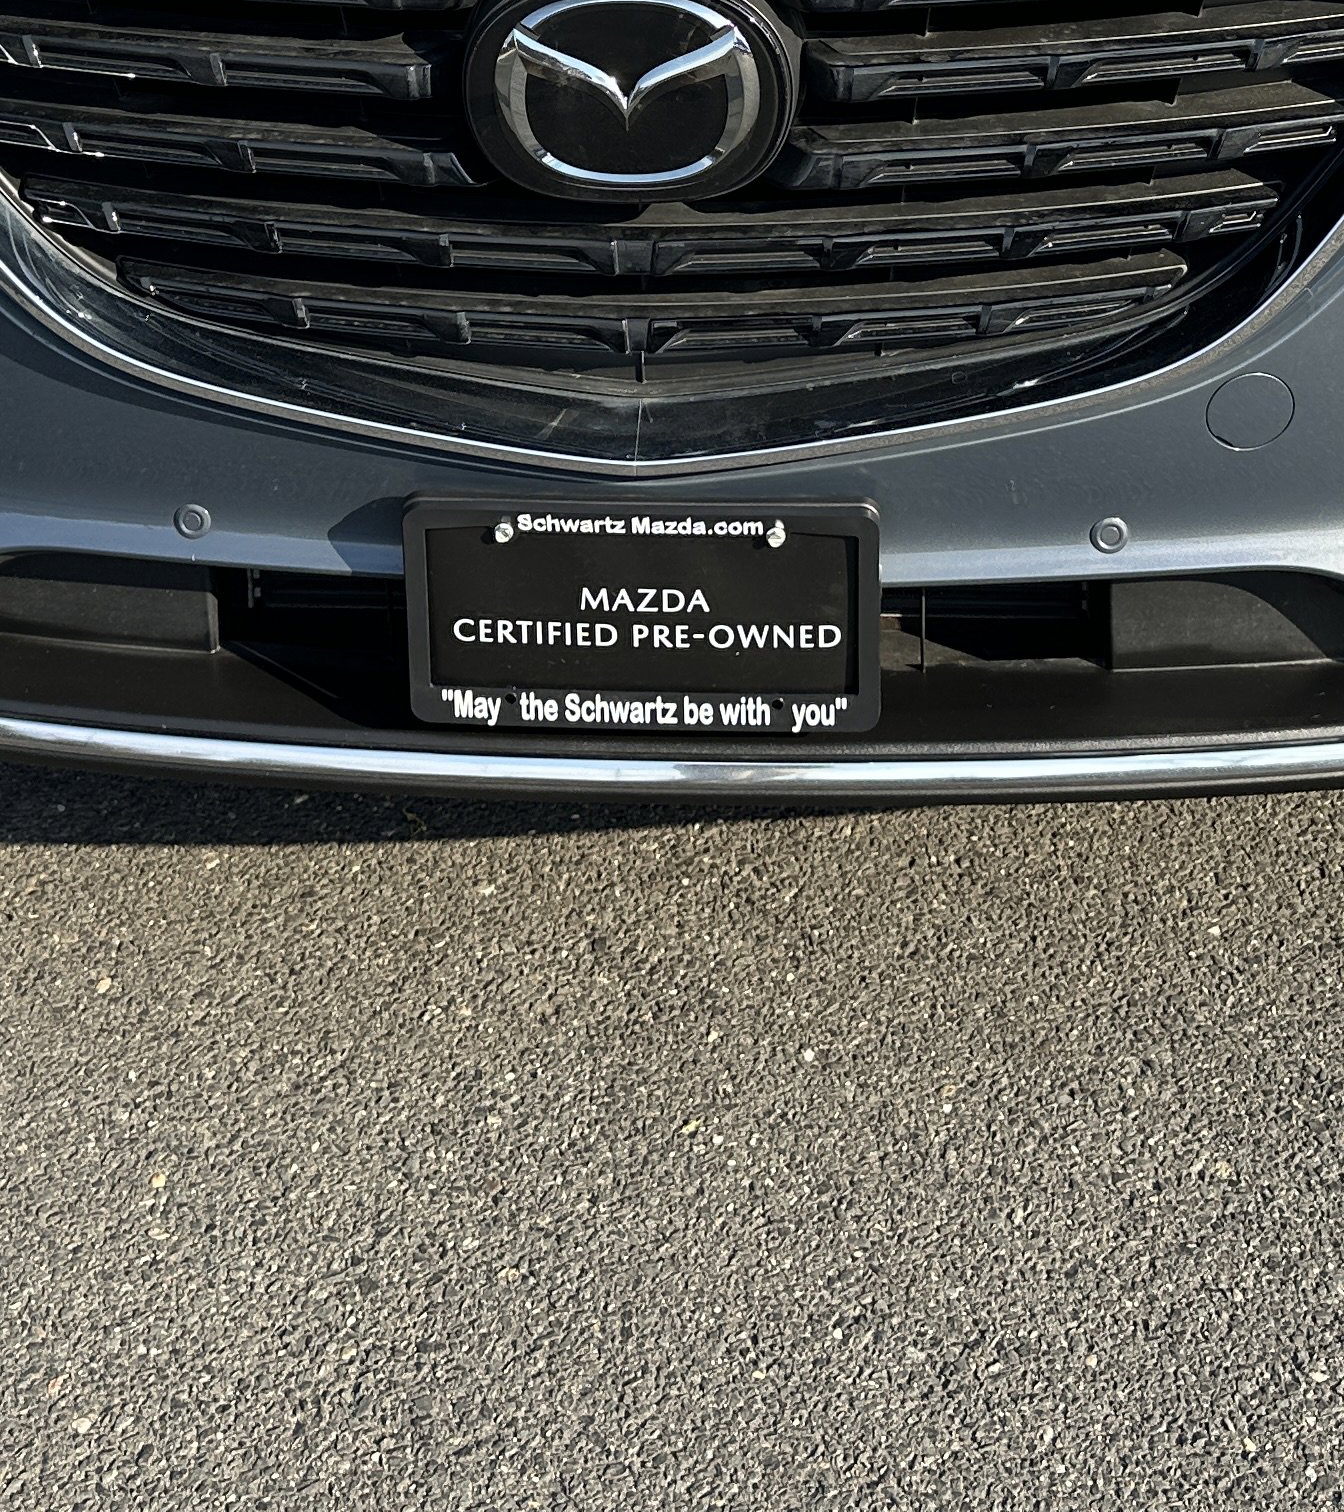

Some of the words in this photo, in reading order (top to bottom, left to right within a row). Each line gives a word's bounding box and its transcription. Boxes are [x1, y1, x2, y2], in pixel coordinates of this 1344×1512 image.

[517, 514, 626, 534] Schwartz
[631, 516, 764, 536] Mazda.com
[580, 587, 710, 613] MAZDA
[453, 618, 618, 647] CERTIFIED
[632, 624, 842, 650] PRE-OWNED
[441, 688, 501, 727] "May
[519, 691, 559, 722] the
[564, 693, 679, 725] Schwartz
[683, 695, 714, 726] be
[719, 696, 771, 726] with
[791, 698, 848, 733] you"
